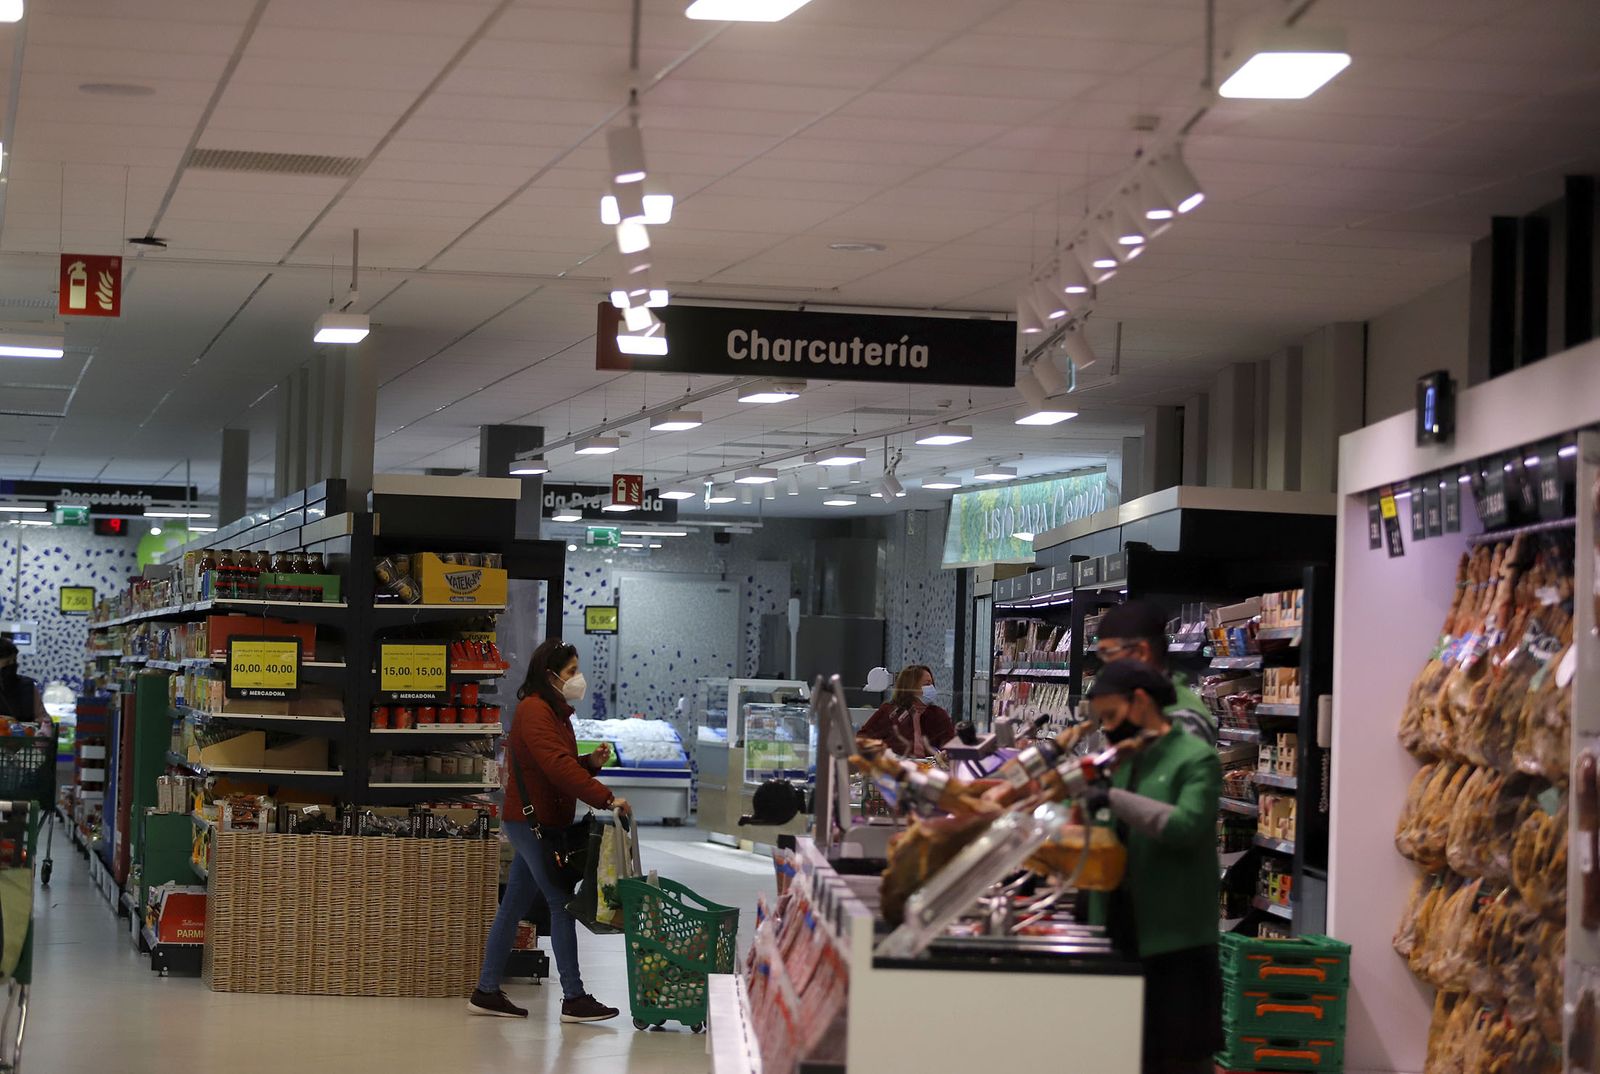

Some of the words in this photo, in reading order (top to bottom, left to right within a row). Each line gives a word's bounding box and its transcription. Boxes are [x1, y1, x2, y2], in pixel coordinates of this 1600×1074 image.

[727, 329, 929, 368] Charcutería
[233, 663, 261, 673] 40,00
[265, 664, 293, 674] 40,00
[384, 667, 410, 676] 15,00
[416, 667, 442, 677] 15,00
